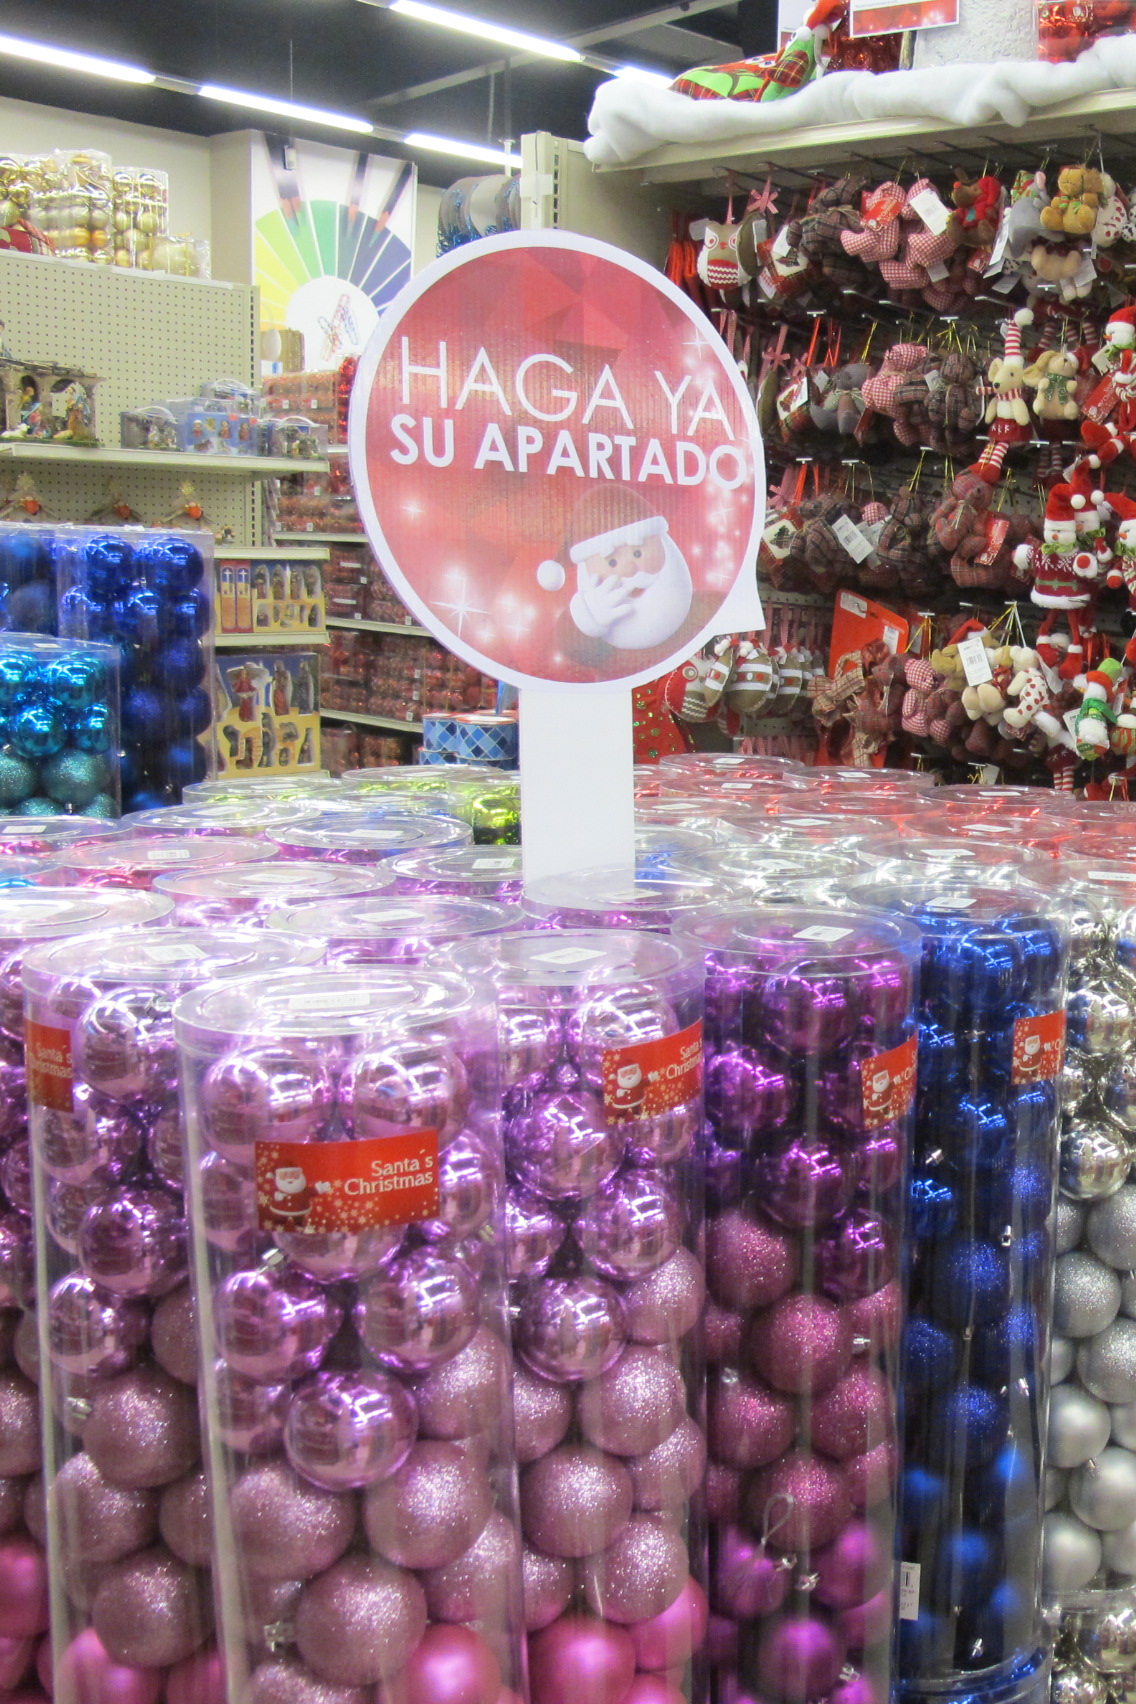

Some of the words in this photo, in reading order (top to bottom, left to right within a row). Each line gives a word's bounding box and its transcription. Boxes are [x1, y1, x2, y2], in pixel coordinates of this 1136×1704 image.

[402, 336, 634, 430] HAGA
[654, 370, 735, 441] YA
[390, 413, 454, 468] SU
[474, 422, 746, 490] APARTADO
[344, 1171, 434, 1196] Christmas
